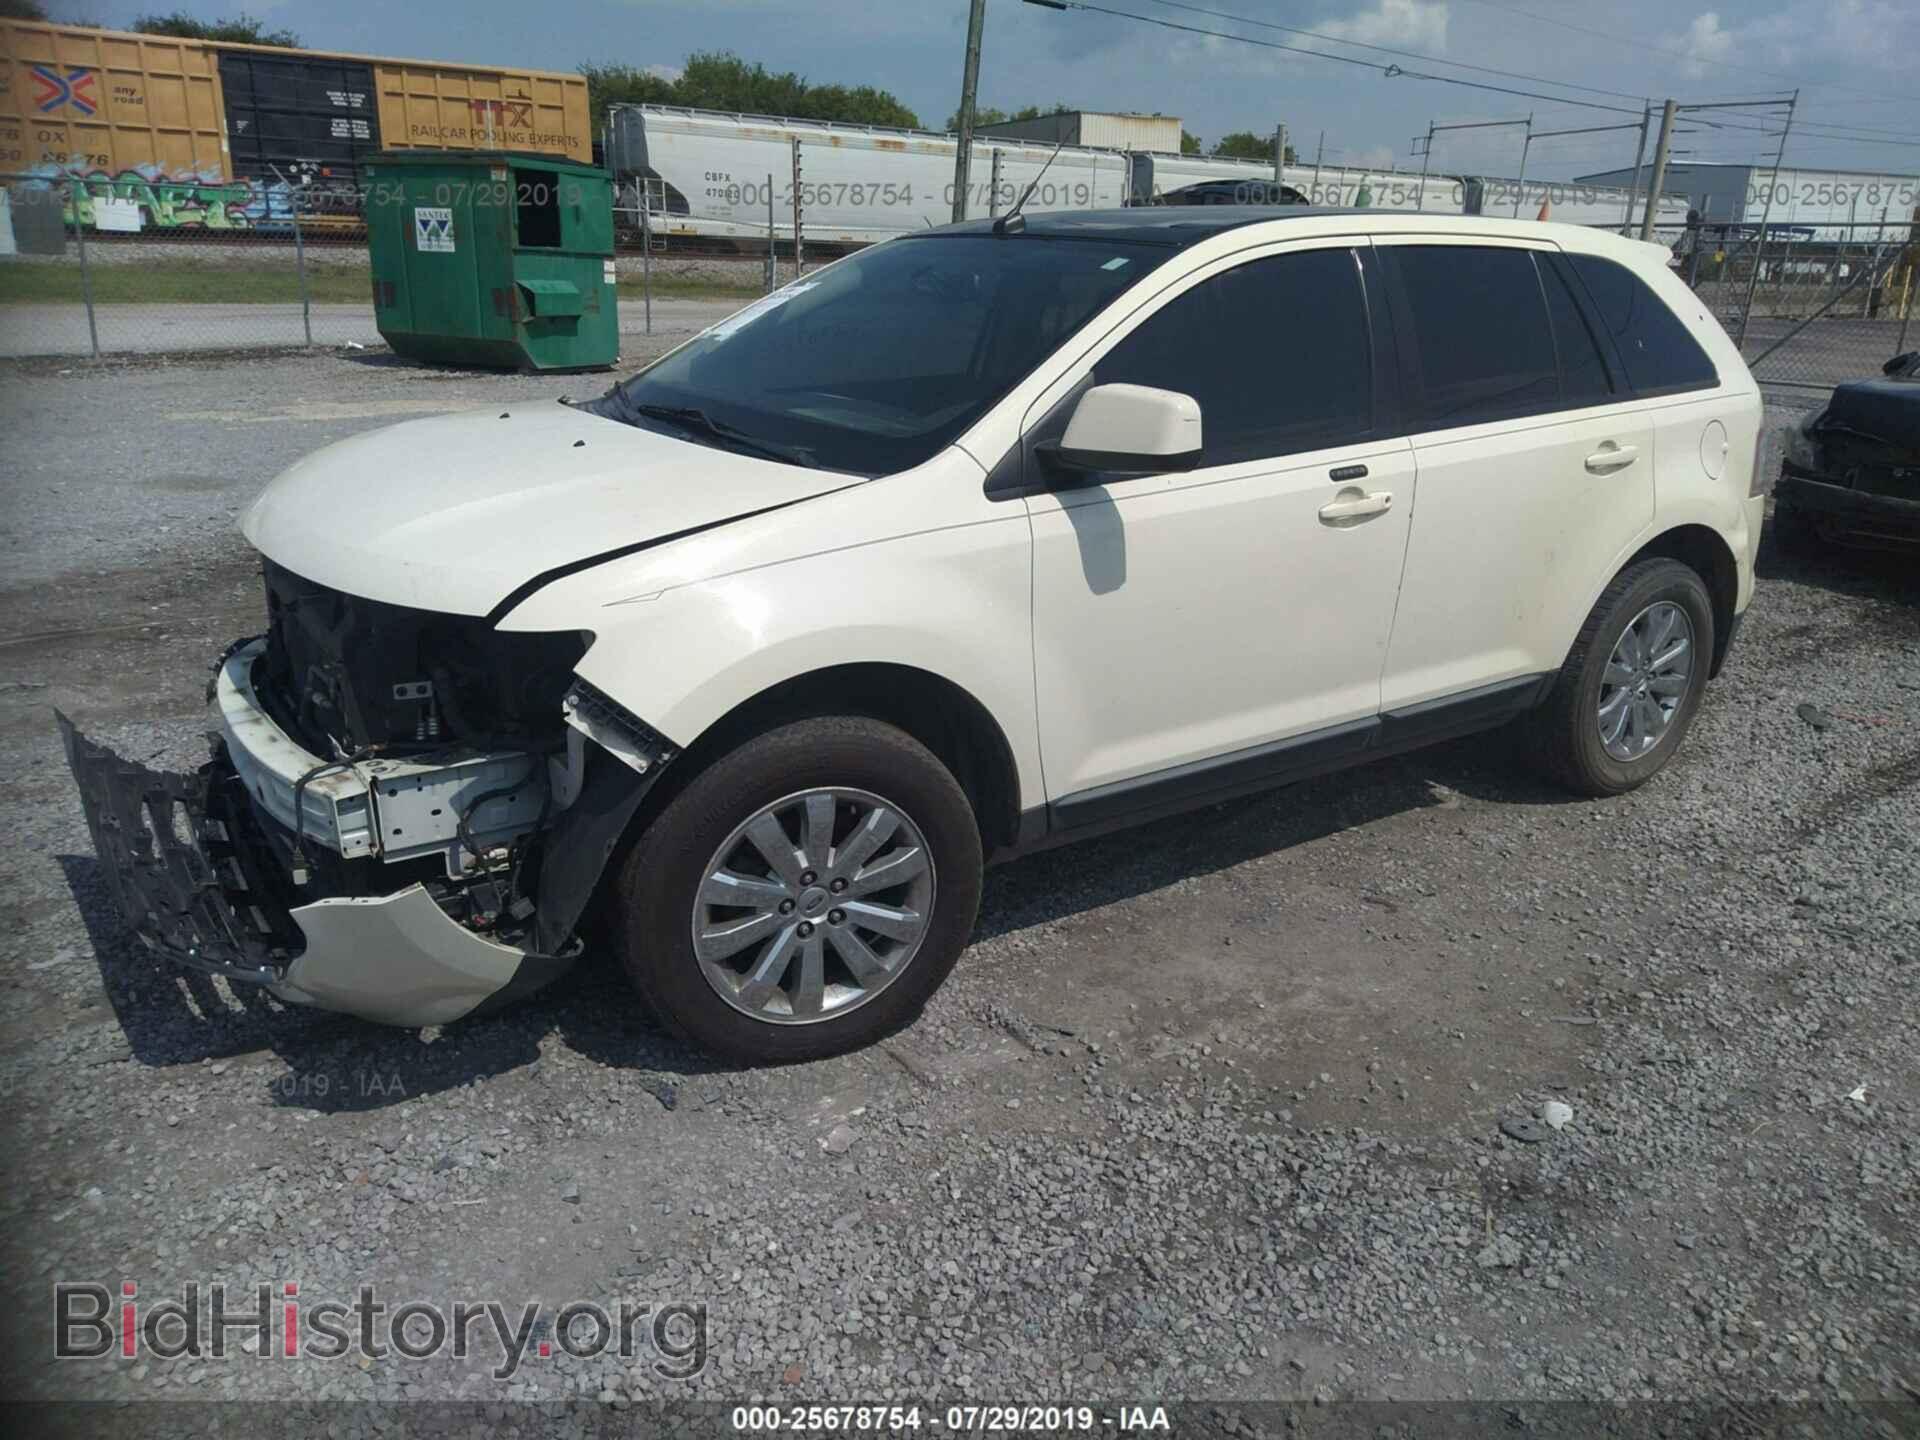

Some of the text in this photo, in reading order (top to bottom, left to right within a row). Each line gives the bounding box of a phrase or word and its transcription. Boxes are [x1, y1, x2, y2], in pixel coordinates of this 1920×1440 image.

[113, 86, 137, 96] any
[114, 96, 144, 105] road
[468, 99, 533, 128] TTX
[411, 124, 580, 148] RAILCAR POOLING EXPERTS
[705, 171, 731, 182] CBFX
